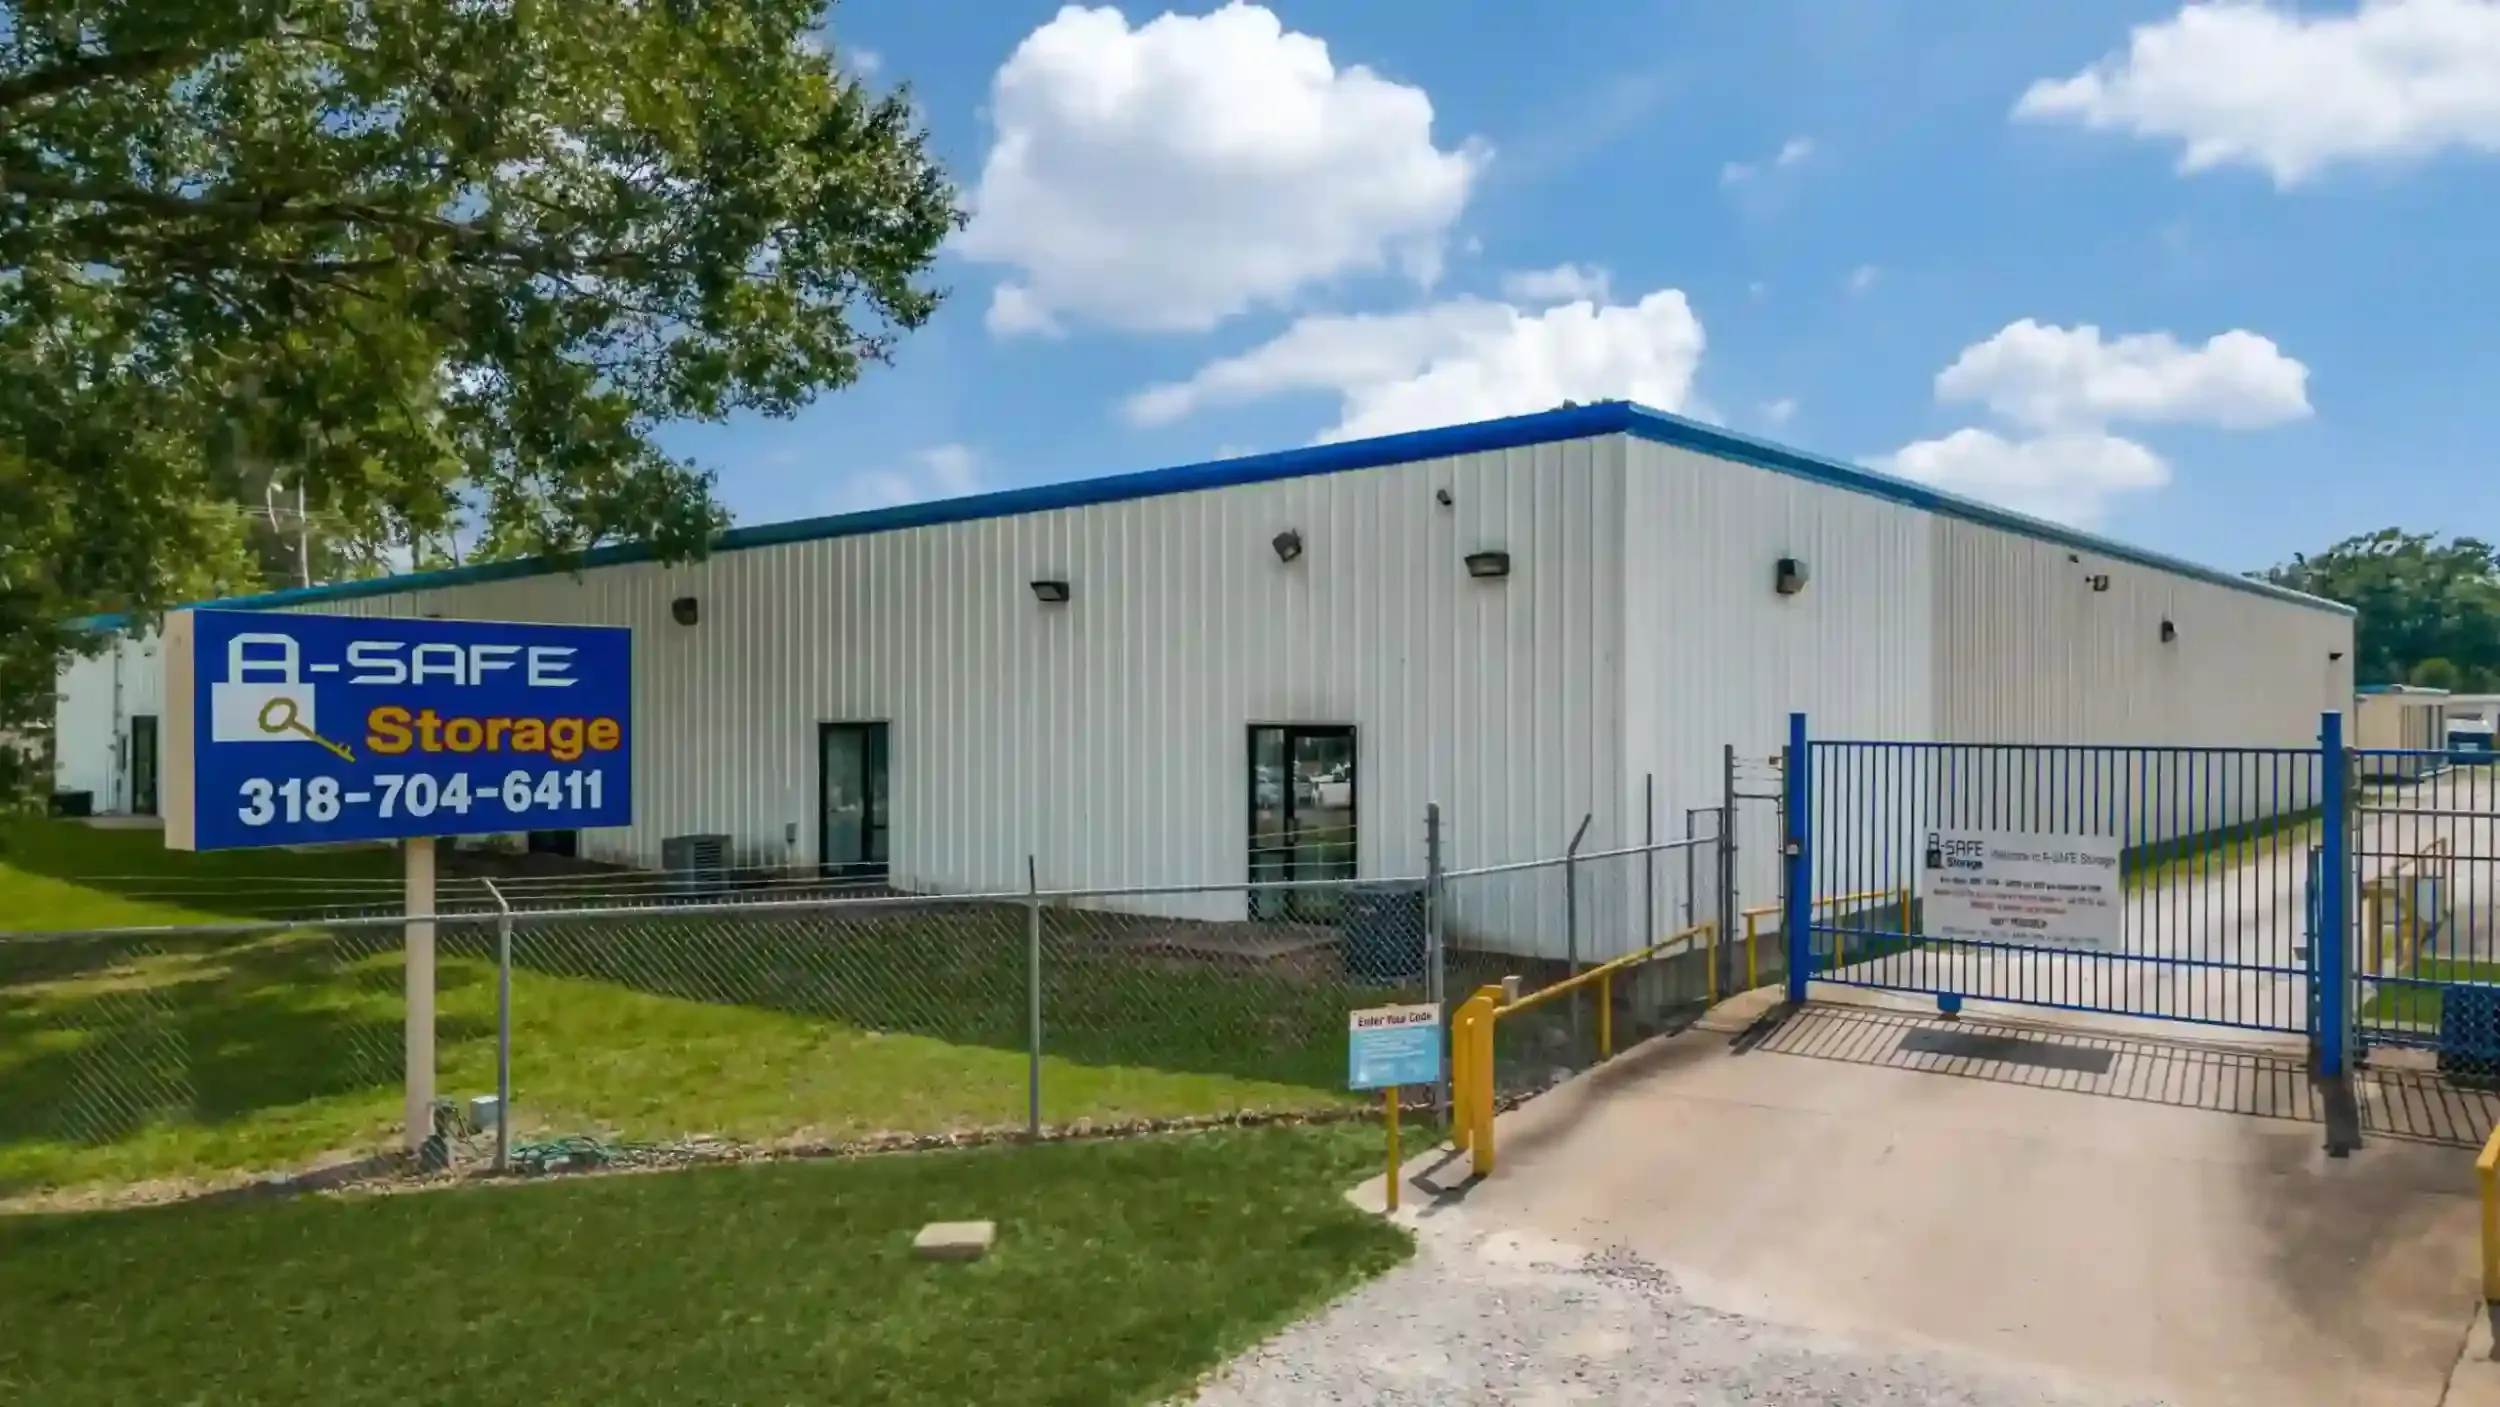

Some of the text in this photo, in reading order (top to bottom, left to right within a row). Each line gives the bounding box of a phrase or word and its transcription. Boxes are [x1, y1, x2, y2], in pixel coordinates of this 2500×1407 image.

[228, 632, 580, 687] A-SAFE
[365, 704, 622, 762] Storage
[238, 769, 602, 826] 318-704-6411
[1928, 832, 1984, 857] A-SAFE
[1946, 858, 1984, 870] Storage
[1358, 1015, 1384, 1027] Enter
